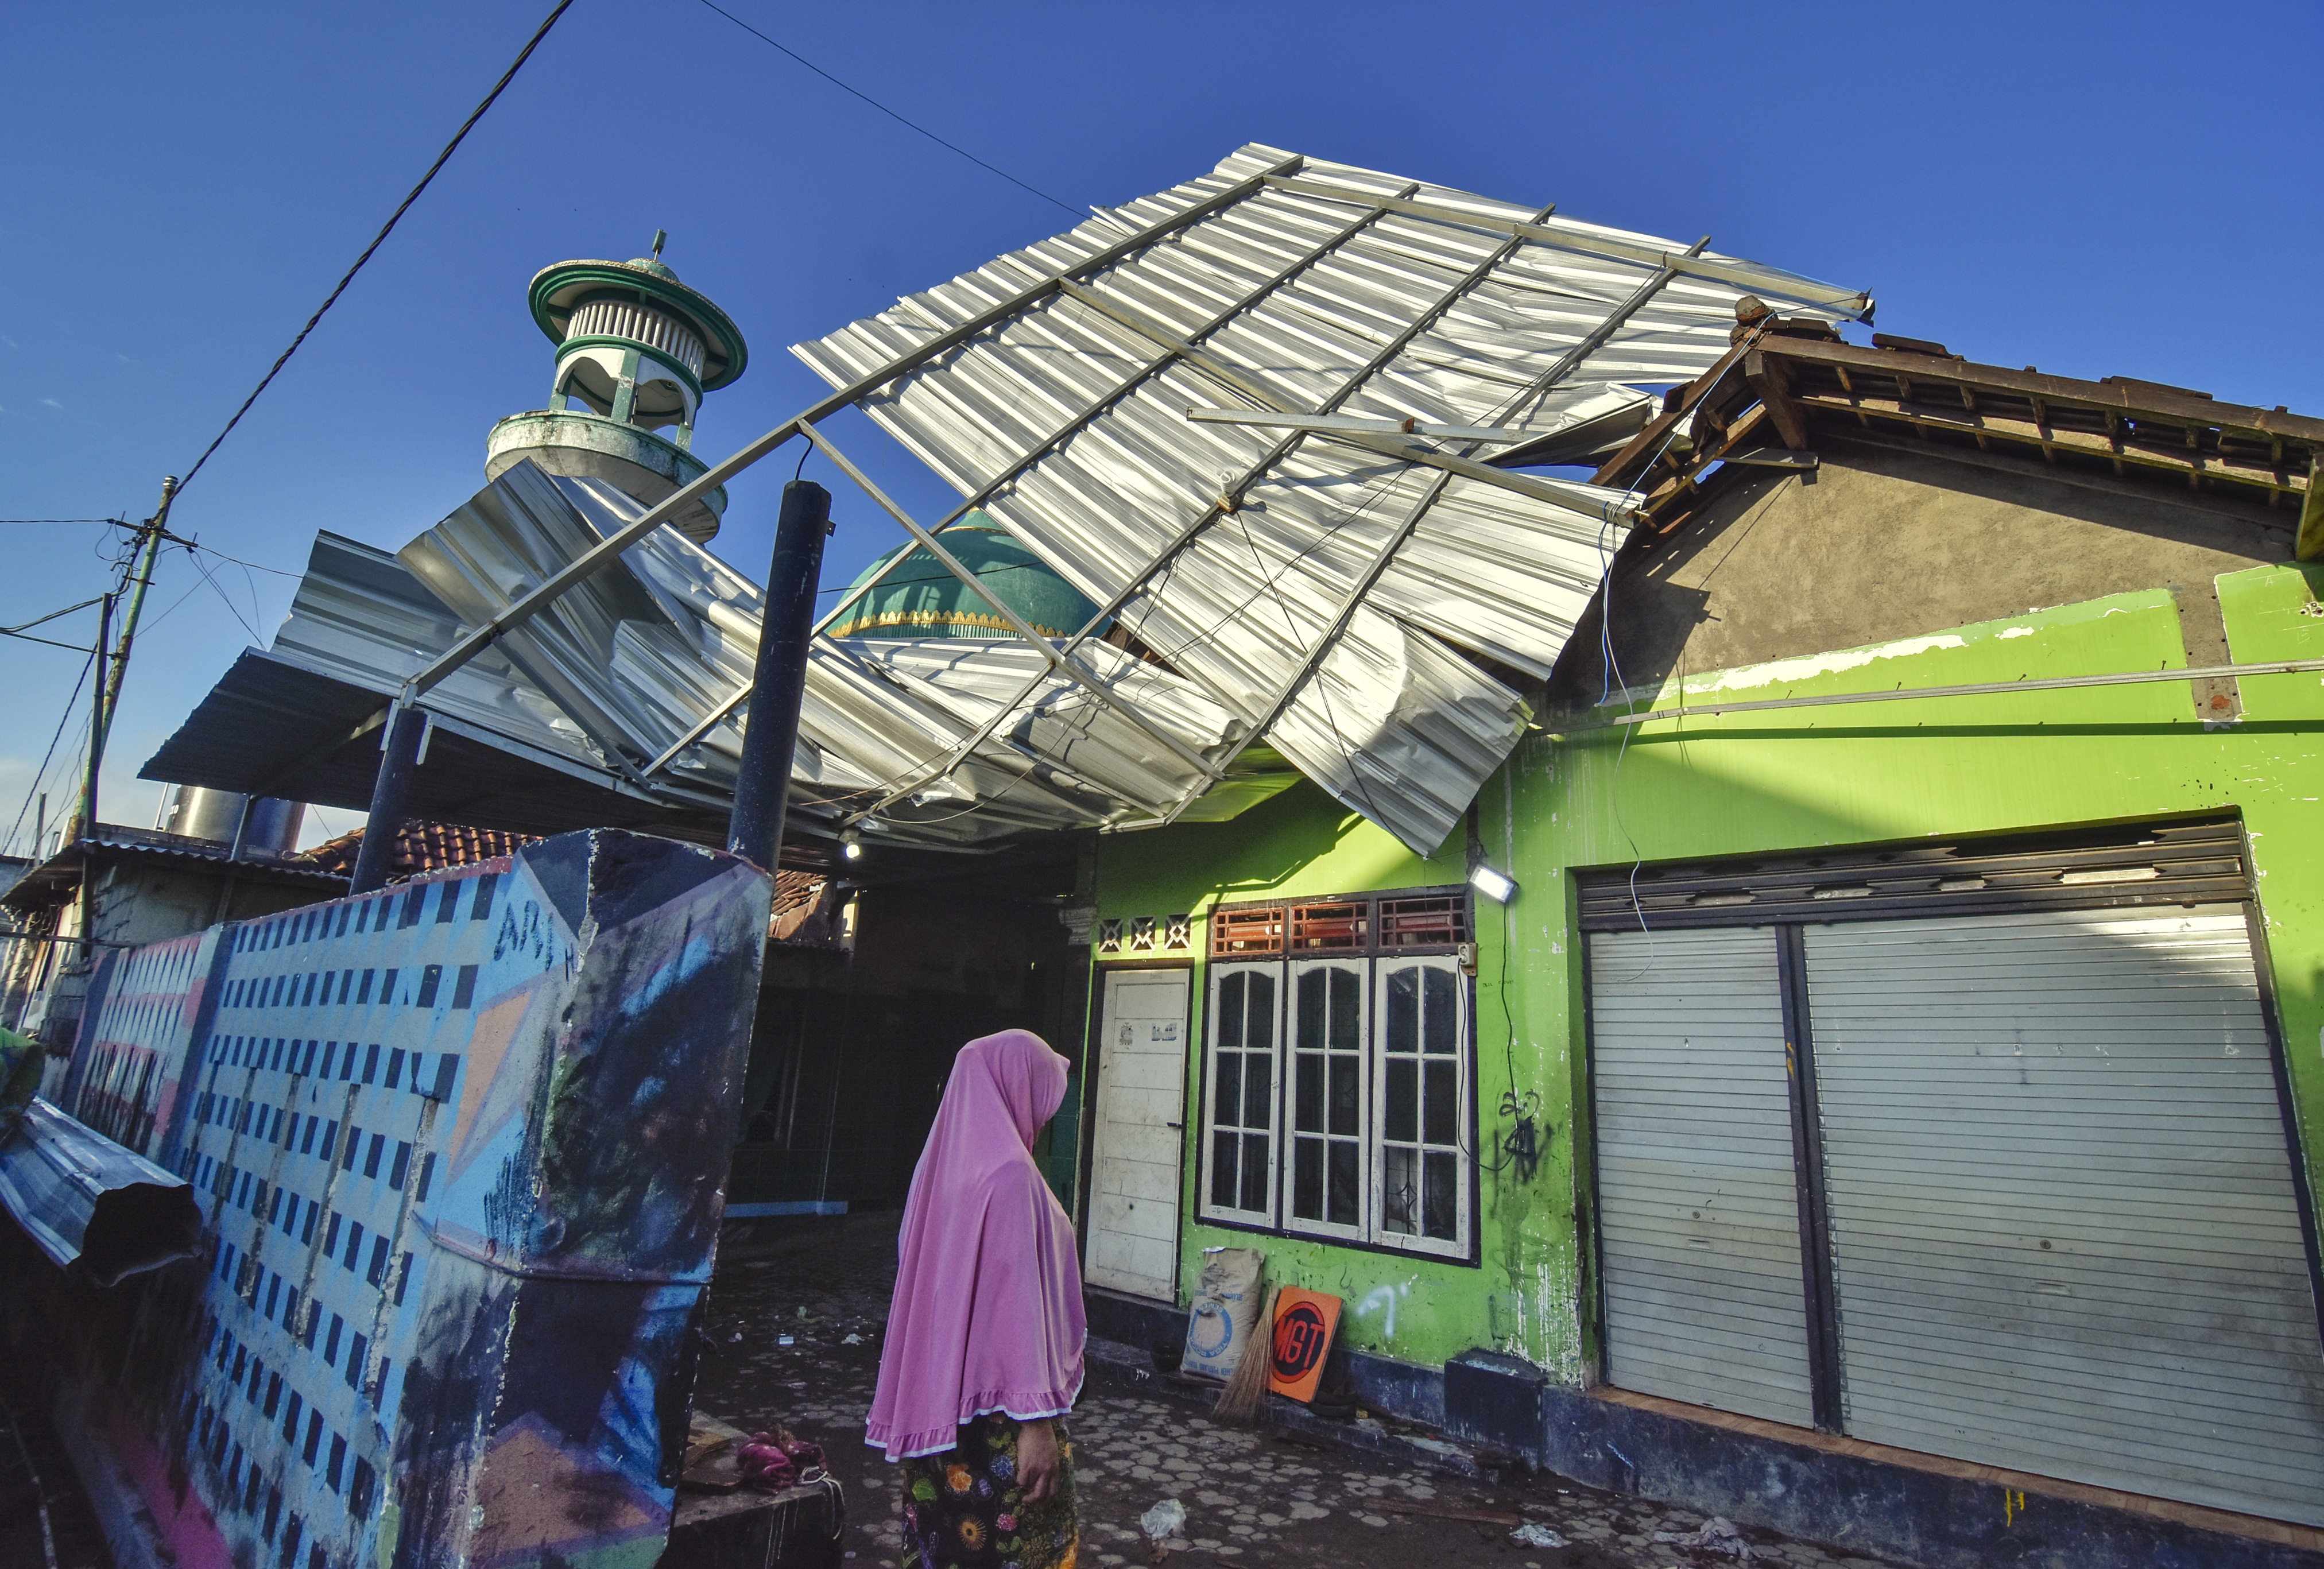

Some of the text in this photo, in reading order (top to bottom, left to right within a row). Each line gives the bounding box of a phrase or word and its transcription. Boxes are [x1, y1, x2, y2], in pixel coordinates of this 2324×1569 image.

[1198, 1303, 1223, 1313] SEMEN
[1209, 1342, 1227, 1357] TIGA
[1273, 1316, 1324, 1369] MGT
